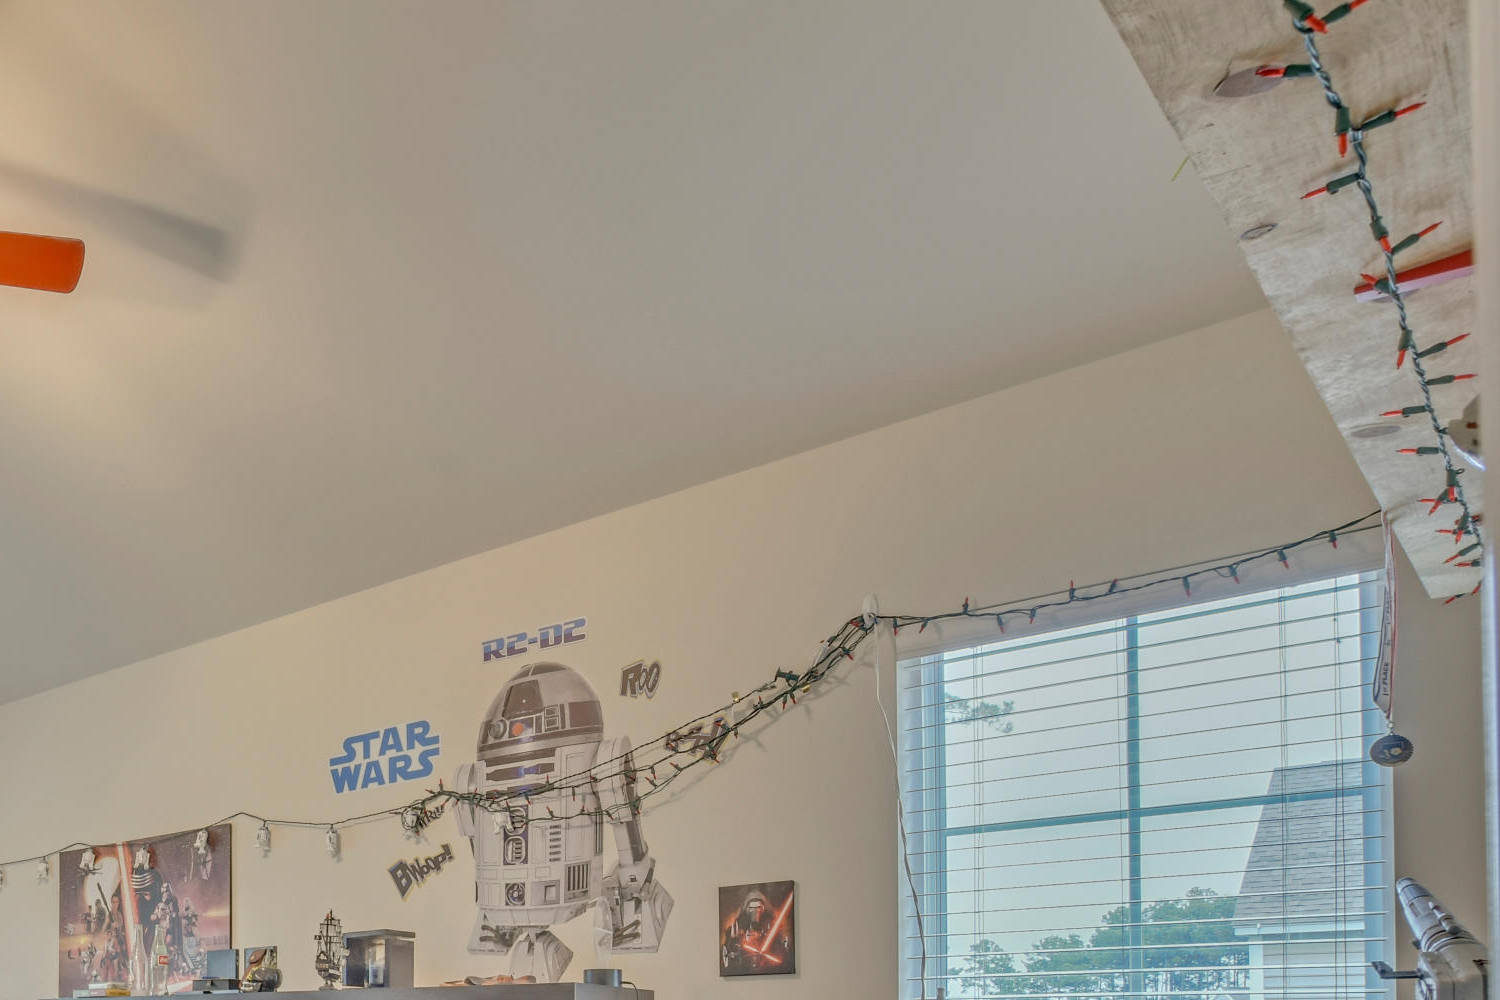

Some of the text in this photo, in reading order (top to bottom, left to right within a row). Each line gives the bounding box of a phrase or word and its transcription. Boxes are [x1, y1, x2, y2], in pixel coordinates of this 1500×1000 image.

[481, 618, 587, 662] R2-D2
[329, 720, 440, 767] STAR
[330, 747, 440, 794] WARS
